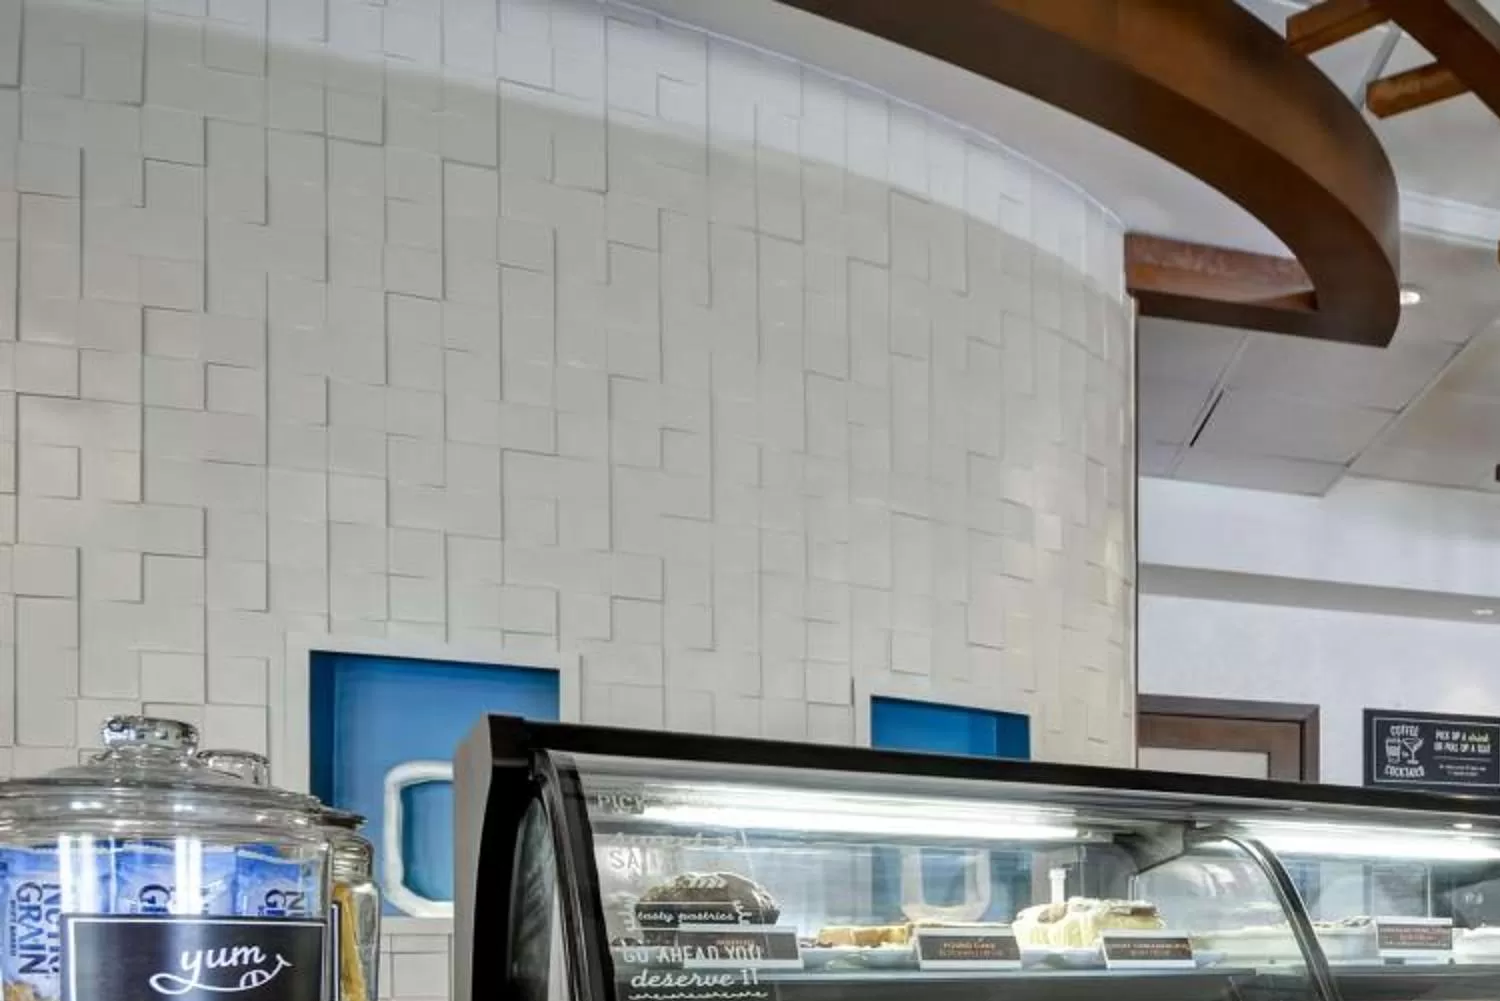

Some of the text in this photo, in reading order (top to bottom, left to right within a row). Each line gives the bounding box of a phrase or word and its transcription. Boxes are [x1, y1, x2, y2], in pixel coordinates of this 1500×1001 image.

[16, 881, 50, 974] GRAIN
[637, 911, 675, 923] tasty
[623, 943, 762, 964] GO AHEAD YOU
[150, 944, 267, 994] yum
[630, 968, 736, 988] deserve
